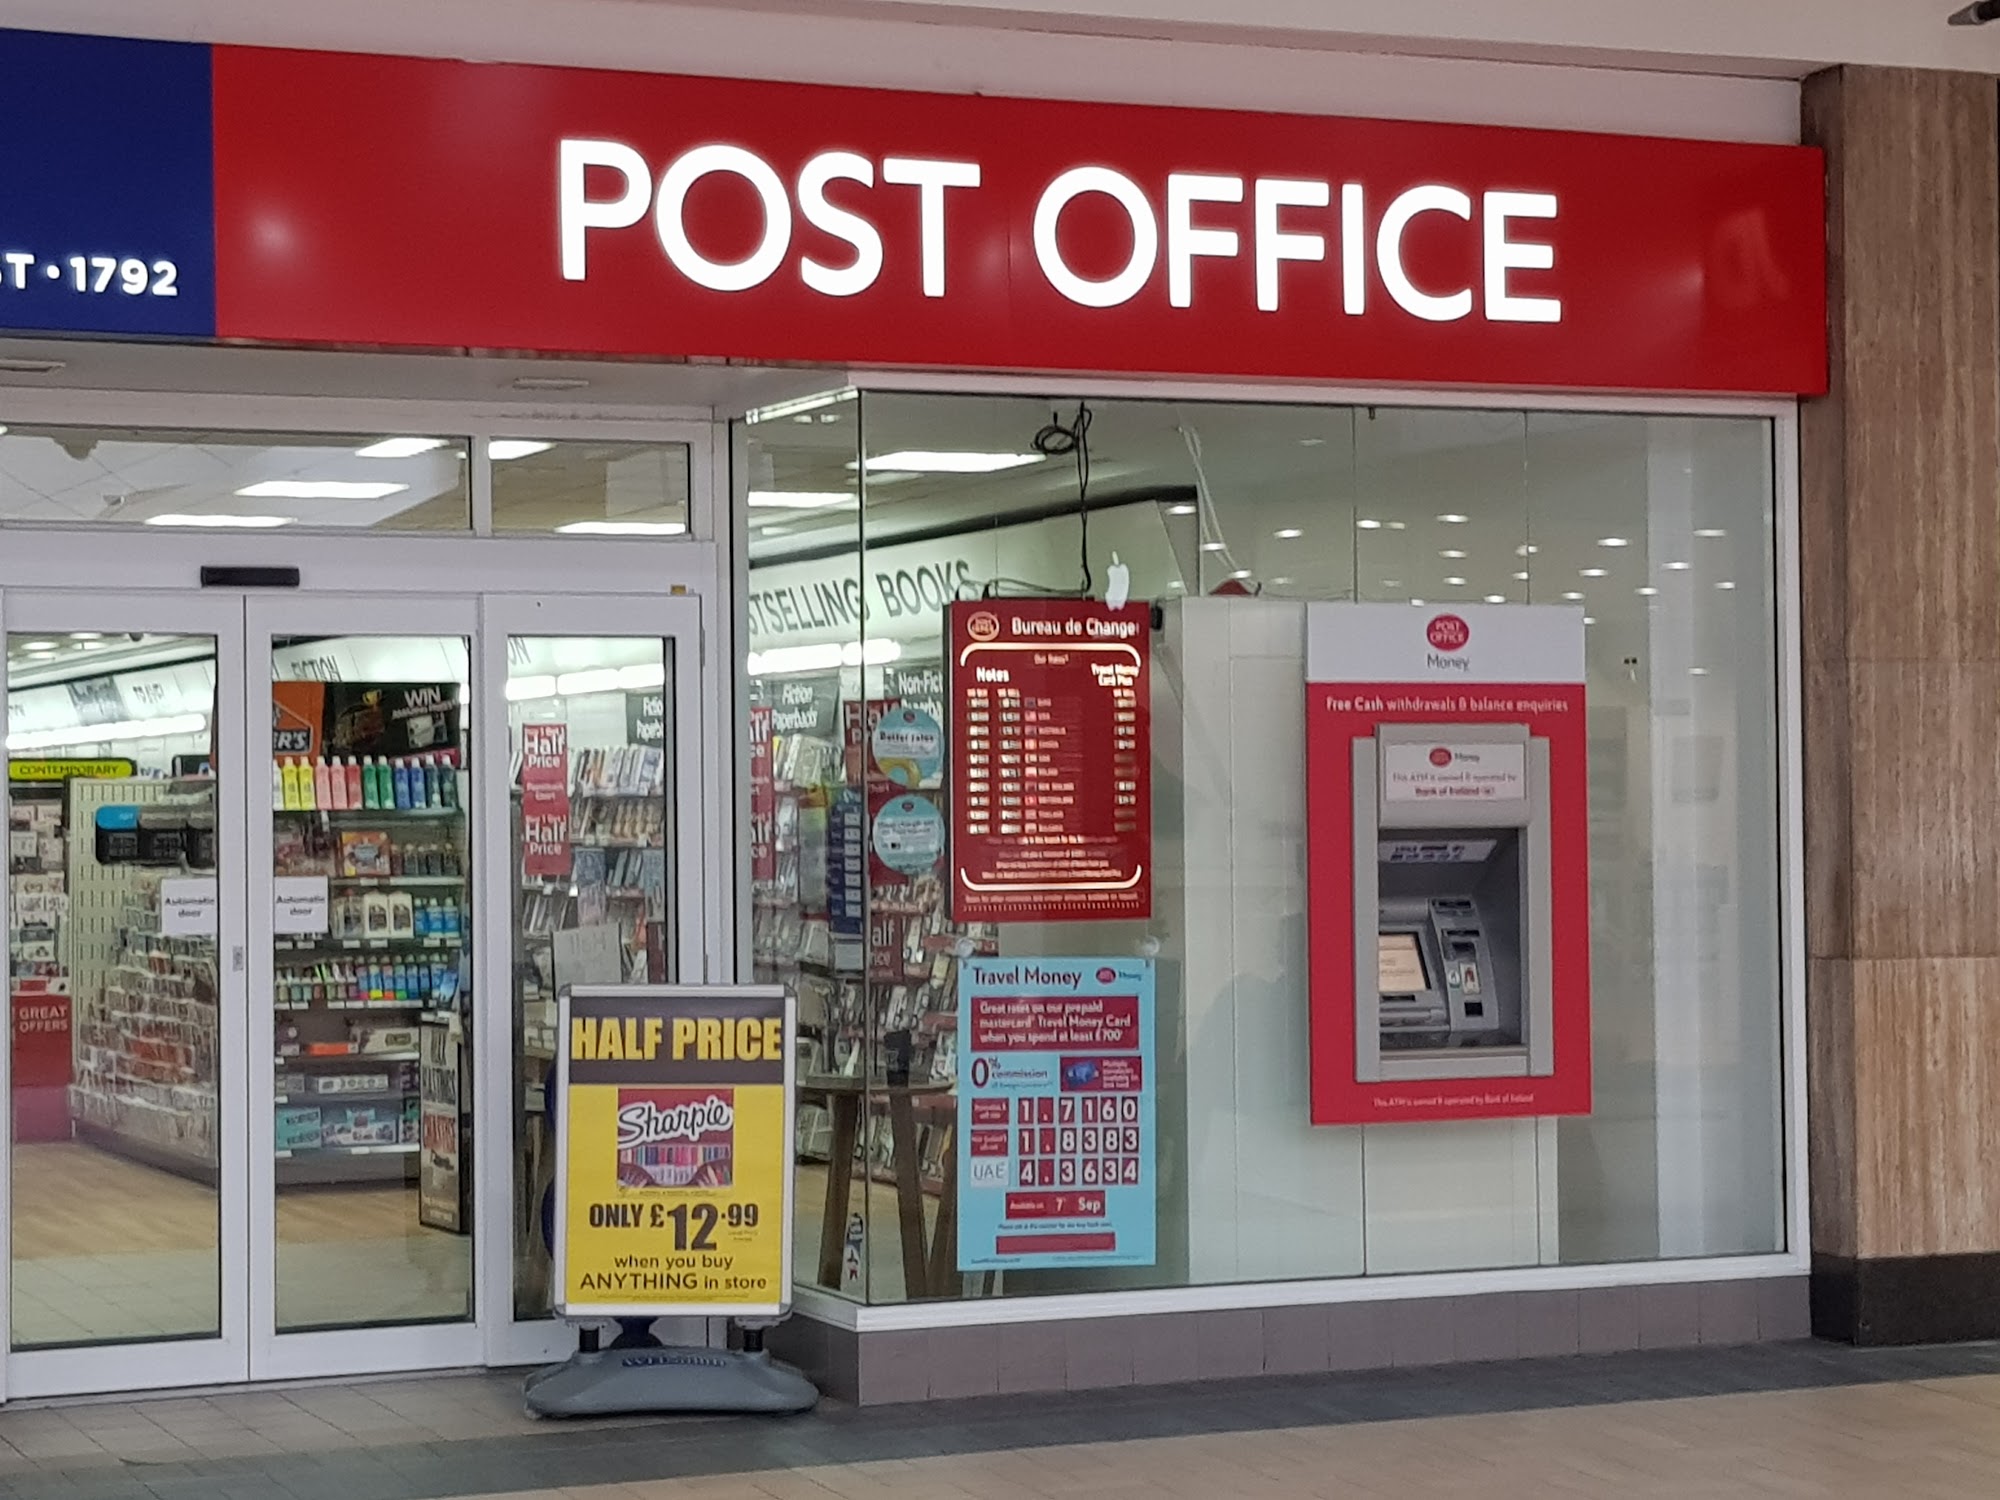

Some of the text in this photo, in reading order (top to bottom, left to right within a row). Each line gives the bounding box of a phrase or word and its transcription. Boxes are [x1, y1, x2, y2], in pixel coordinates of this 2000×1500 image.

[560, 139, 1562, 322] POST OFFICE
[70, 256, 178, 296] 1792
[876, 559, 974, 618] BOOKS
[1012, 617, 1061, 635] Bureau
[1065, 617, 1082, 635] de
[1086, 618, 1136, 639] Change
[1427, 653, 1470, 671] Money
[976, 667, 1010, 683] Notes
[404, 685, 441, 709] WIN
[1326, 697, 1350, 711] Free
[1355, 697, 1383, 712] Cash
[1387, 698, 1456, 712] withdrawals
[1470, 698, 1513, 712] balance
[1516, 699, 1568, 715] enquiries
[524, 729, 565, 755] Half
[20, 764, 118, 776] CONTEMPORARY
[528, 753, 560, 769] Price
[525, 819, 567, 842] Half
[530, 842, 561, 856] Price
[165, 897, 215, 906] Automatic
[276, 895, 325, 904] Automatic
[178, 908, 201, 918] door
[290, 907, 312, 916] door
[972, 965, 1082, 989] Travel Money
[19, 1005, 68, 1020] GREAT
[980, 1000, 1005, 1014] Great
[1007, 1001, 1030, 1014] rates
[1064, 1000, 1103, 1017] prepaid
[20, 1019, 68, 1033] OFFERS
[1038, 1015, 1067, 1027] Travel
[1069, 1015, 1103, 1029] Money
[1106, 1014, 1130, 1026] Card
[571, 1017, 782, 1060] HALF PRICE
[980, 1030, 1006, 1043] when
[1007, 1032, 1026, 1046] you
[1028, 1029, 1057, 1045] spend
[1059, 1030, 1069, 1041] at
[1070, 1028, 1094, 1042] least
[618, 1097, 731, 1147] Sharpie
[974, 1162, 1005, 1181] UAE
[1078, 1197, 1101, 1213] Sep
[589, 1203, 644, 1228] ONLY
[614, 1254, 733, 1272] when you buy
[580, 1273, 767, 1290] ANYTHING in store
